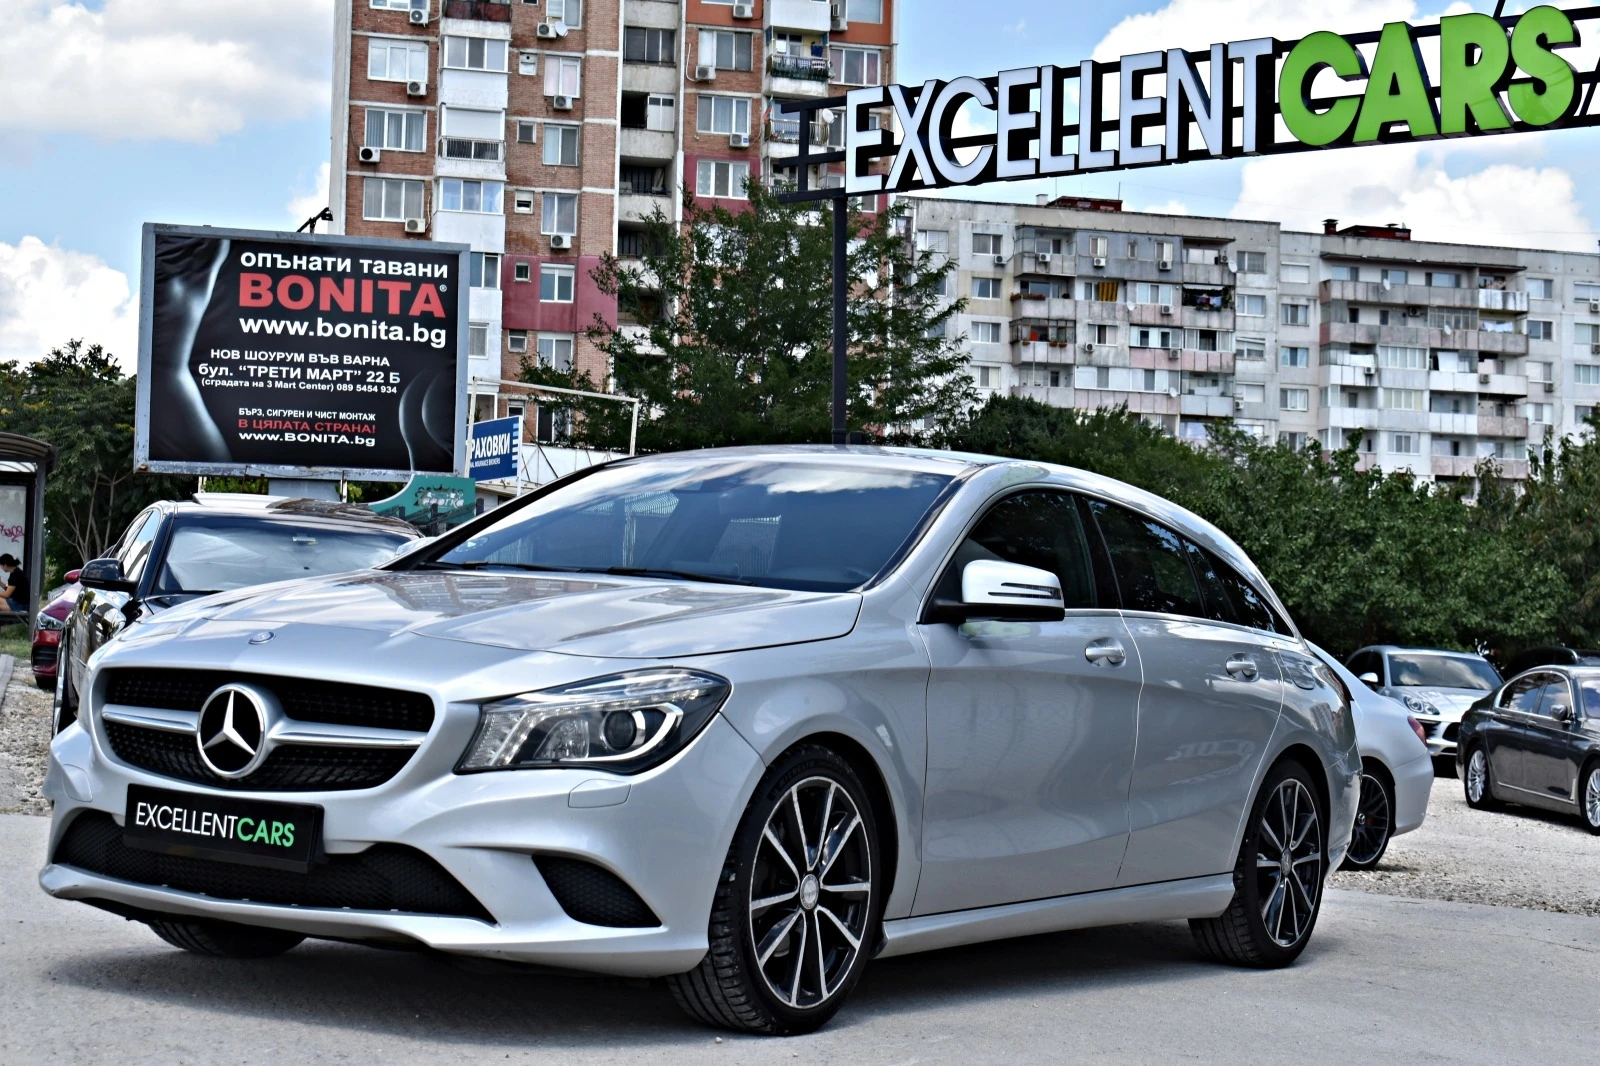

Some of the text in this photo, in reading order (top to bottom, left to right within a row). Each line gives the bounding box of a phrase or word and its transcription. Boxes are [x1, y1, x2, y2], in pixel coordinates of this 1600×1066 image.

[240, 252, 448, 278] опънати тавани
[239, 317, 446, 349] www.bonita.bg
[210, 349, 390, 366] НОВ ШОУРУМ ВЪВ ВАРНА
[198, 363, 234, 377] бул.
[366, 371, 384, 383] 22
[390, 372, 400, 384] Б
[201, 378, 250, 388] (сградата
[266, 380, 272, 388] 3
[274, 381, 297, 390] Mart
[299, 382, 334, 392] Center)
[336, 384, 354, 392] 089
[356, 384, 378, 393] 5454
[380, 386, 398, 394] 934
[238, 408, 376, 421] БЪРЗ, СИГУРЕН И ЧИСТ МОНТАЖ
[238, 420, 376, 433] В ЦЯЛАТА СТРАНА!
[238, 432, 376, 447] www.BONITA.bg
